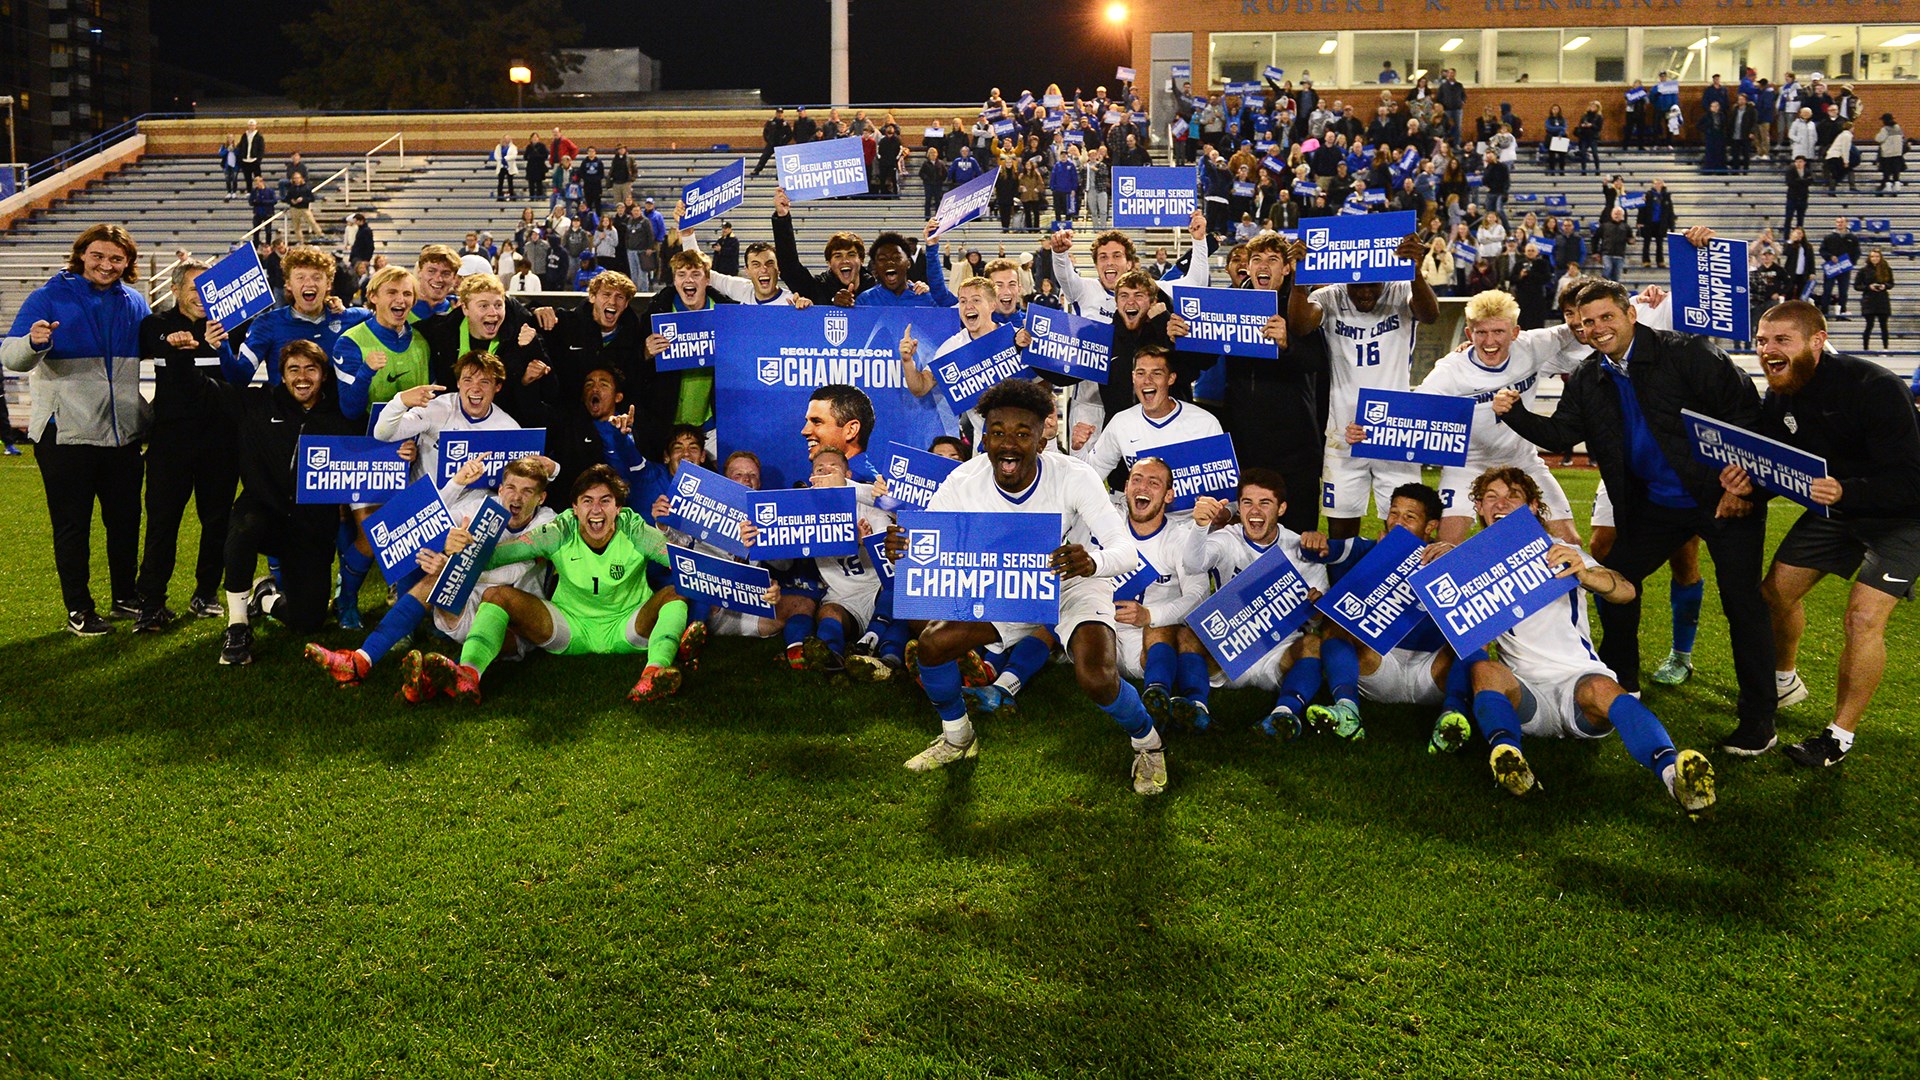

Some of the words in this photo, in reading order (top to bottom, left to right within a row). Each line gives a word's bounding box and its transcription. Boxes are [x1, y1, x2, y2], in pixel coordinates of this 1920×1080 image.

[800, 161, 832, 172] REGULAR
[834, 157, 861, 167] SEASON
[784, 166, 864, 191] CHAMPIONS
[684, 182, 742, 220] CHAMPIONS
[1119, 198, 1195, 215] CHAMPIONS
[1136, 189, 1166, 198] REGULAR
[1168, 189, 1194, 198] SEASON
[1328, 239, 1370, 250] REGULAR
[1374, 236, 1404, 248] SEASO
[1698, 246, 1708, 272] SEASO
[209, 274, 268, 322] CHAMPIONS
[1699, 274, 1710, 310] REGULAR
[1710, 241, 1733, 332] CHAMPIONS
[827, 320, 845, 331] SLU
[1200, 312, 1237, 323] REGULAR
[1240, 314, 1268, 326] SEASO
[1335, 320, 1366, 340] SAINT
[1370, 314, 1400, 337] LOUIS
[677, 332, 708, 341] REGULAR
[1048, 332, 1080, 347] REGULAR
[1082, 340, 1109, 354] SEASON
[662, 340, 715, 360] CHAMPI
[780, 348, 839, 358] REGULAR
[840, 348, 892, 358] SEASON
[961, 358, 992, 378] REGULAR
[994, 346, 1018, 363] SEASO
[1028, 337, 1108, 372] CHAMPIONS
[1356, 341, 1380, 368] 16
[784, 358, 908, 388] CHAMPION
[1386, 416, 1427, 430] REGULAR
[1430, 420, 1467, 434] SEASON
[1361, 425, 1466, 454] CHAMPIONS
[330, 460, 369, 471] REGULAR
[372, 460, 406, 471] SEASON
[1172, 464, 1201, 479] EGULAR
[1202, 458, 1234, 471] SEASON
[1699, 441, 1813, 500] CHAMPION
[1723, 442, 1772, 466] REGULAR
[1776, 462, 1813, 483] SEASO
[306, 472, 406, 490] CHAMPIONS
[886, 478, 935, 507] CHAMP
[905, 472, 936, 490] REGULAR
[1172, 470, 1239, 498] AMPIONS
[693, 492, 728, 514] REGULAR
[728, 508, 748, 522] SEAS
[1322, 482, 1334, 508] 6
[670, 494, 746, 543] CHAMPION
[777, 514, 816, 526] REGULAR
[819, 512, 852, 524] SEASON
[380, 510, 453, 570] CHAMPIONS
[757, 523, 855, 547] CHAMPIONS
[436, 508, 496, 606] CHAMPIONS
[914, 546, 934, 554] 10
[940, 552, 998, 567] REGULAR
[1003, 553, 1051, 568] SEASON
[610, 566, 624, 574] SLU
[1363, 572, 1402, 606] REGULAR
[1396, 545, 1424, 578] SEASON
[1460, 562, 1508, 599] REGULAR
[1506, 536, 1548, 566] SEASON
[592, 576, 599, 595] 1
[680, 574, 771, 609] CHAMPIONS
[696, 571, 732, 588] REGULAR
[734, 580, 768, 595] SEASON
[906, 568, 1055, 600] CHAMPIONS
[1437, 586, 1456, 602] 10
[1228, 596, 1266, 630] REGULAR
[1262, 570, 1297, 600] SEASON
[1358, 574, 1419, 639] CHAMP
[1218, 580, 1309, 663] CHAMPIONS
